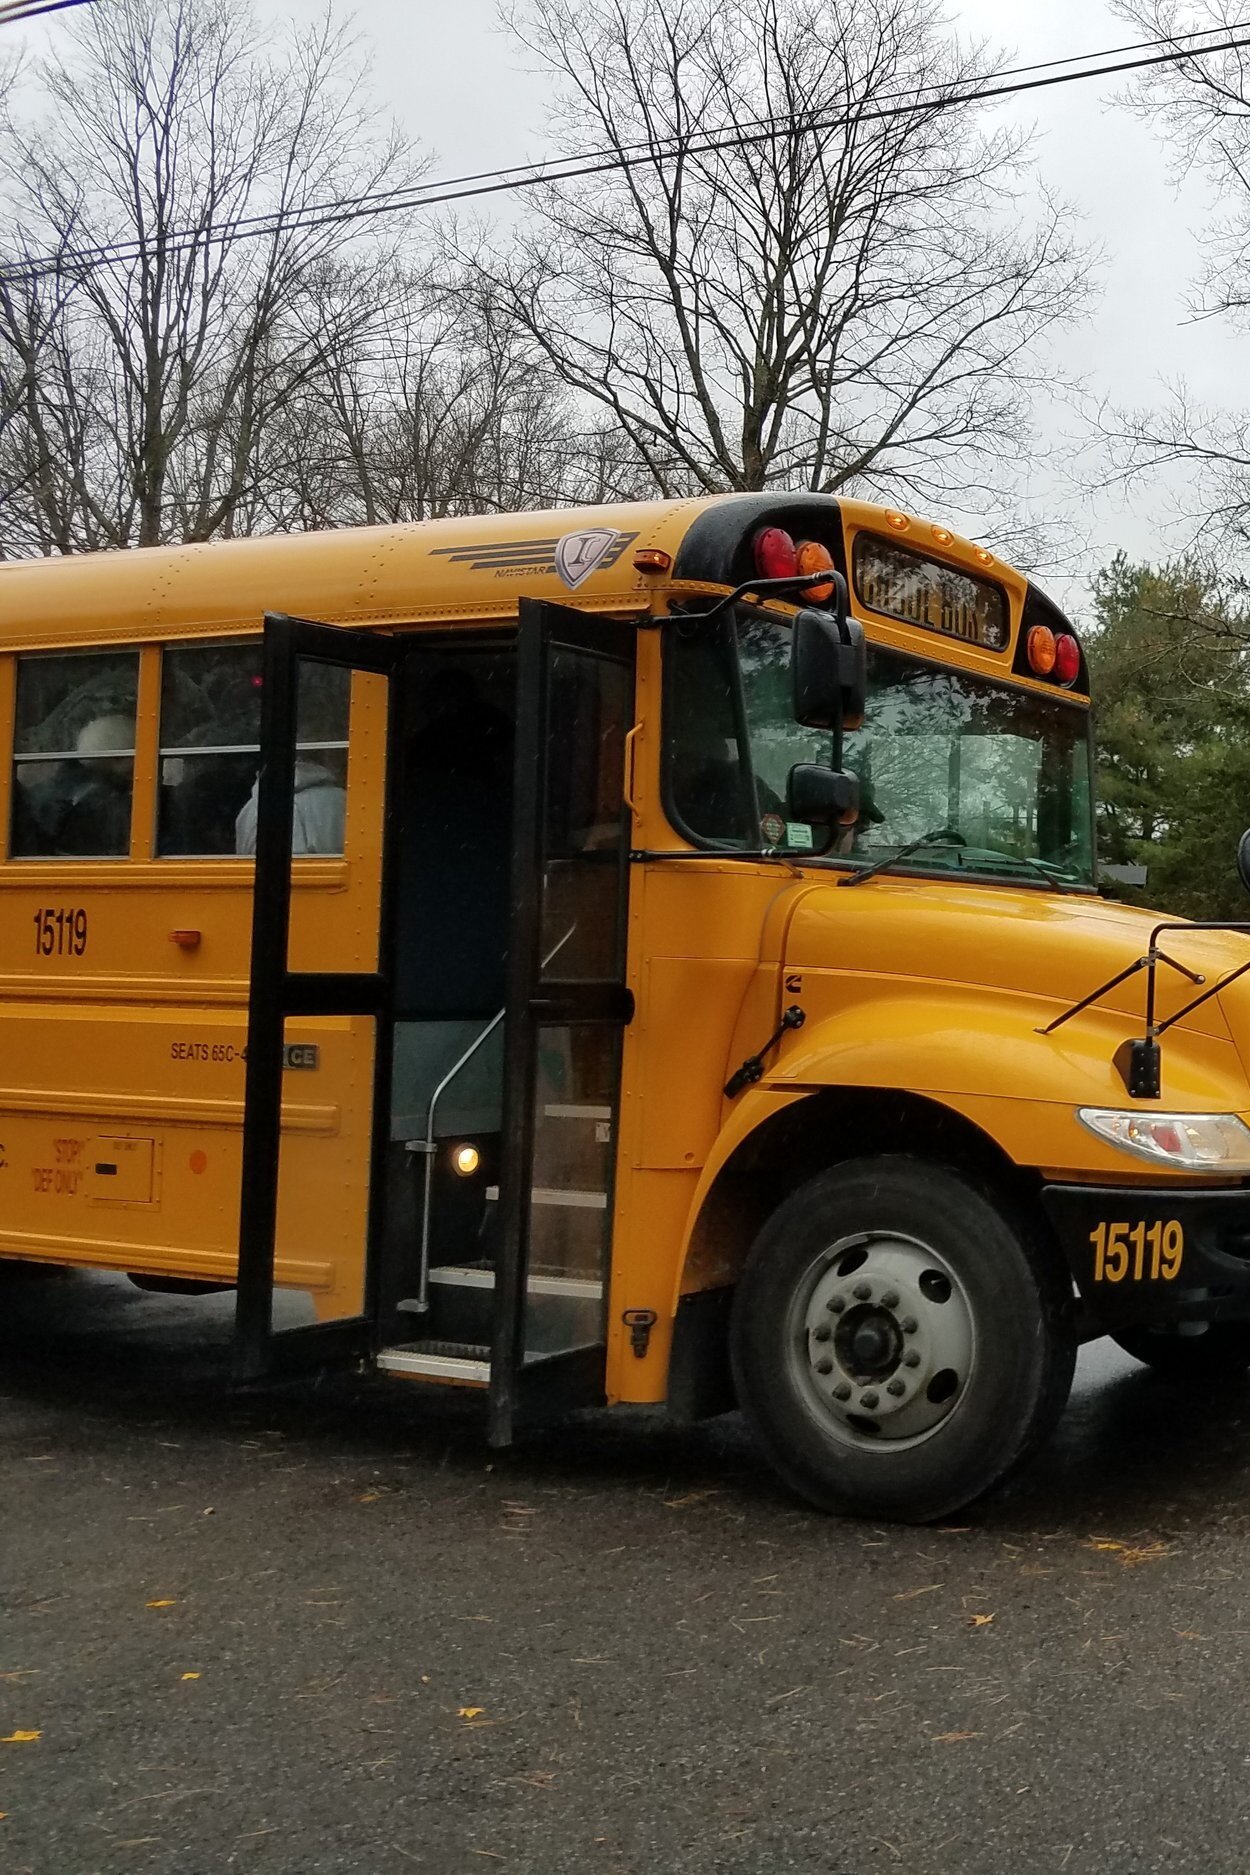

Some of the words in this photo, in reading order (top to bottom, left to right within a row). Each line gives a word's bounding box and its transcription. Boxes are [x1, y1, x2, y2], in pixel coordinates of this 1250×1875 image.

[494, 566, 546, 577] NAVISTAR
[33, 908, 87, 956] 15119
[171, 1043, 209, 1060] SEATS
[1089, 1220, 1184, 1282] 15119
